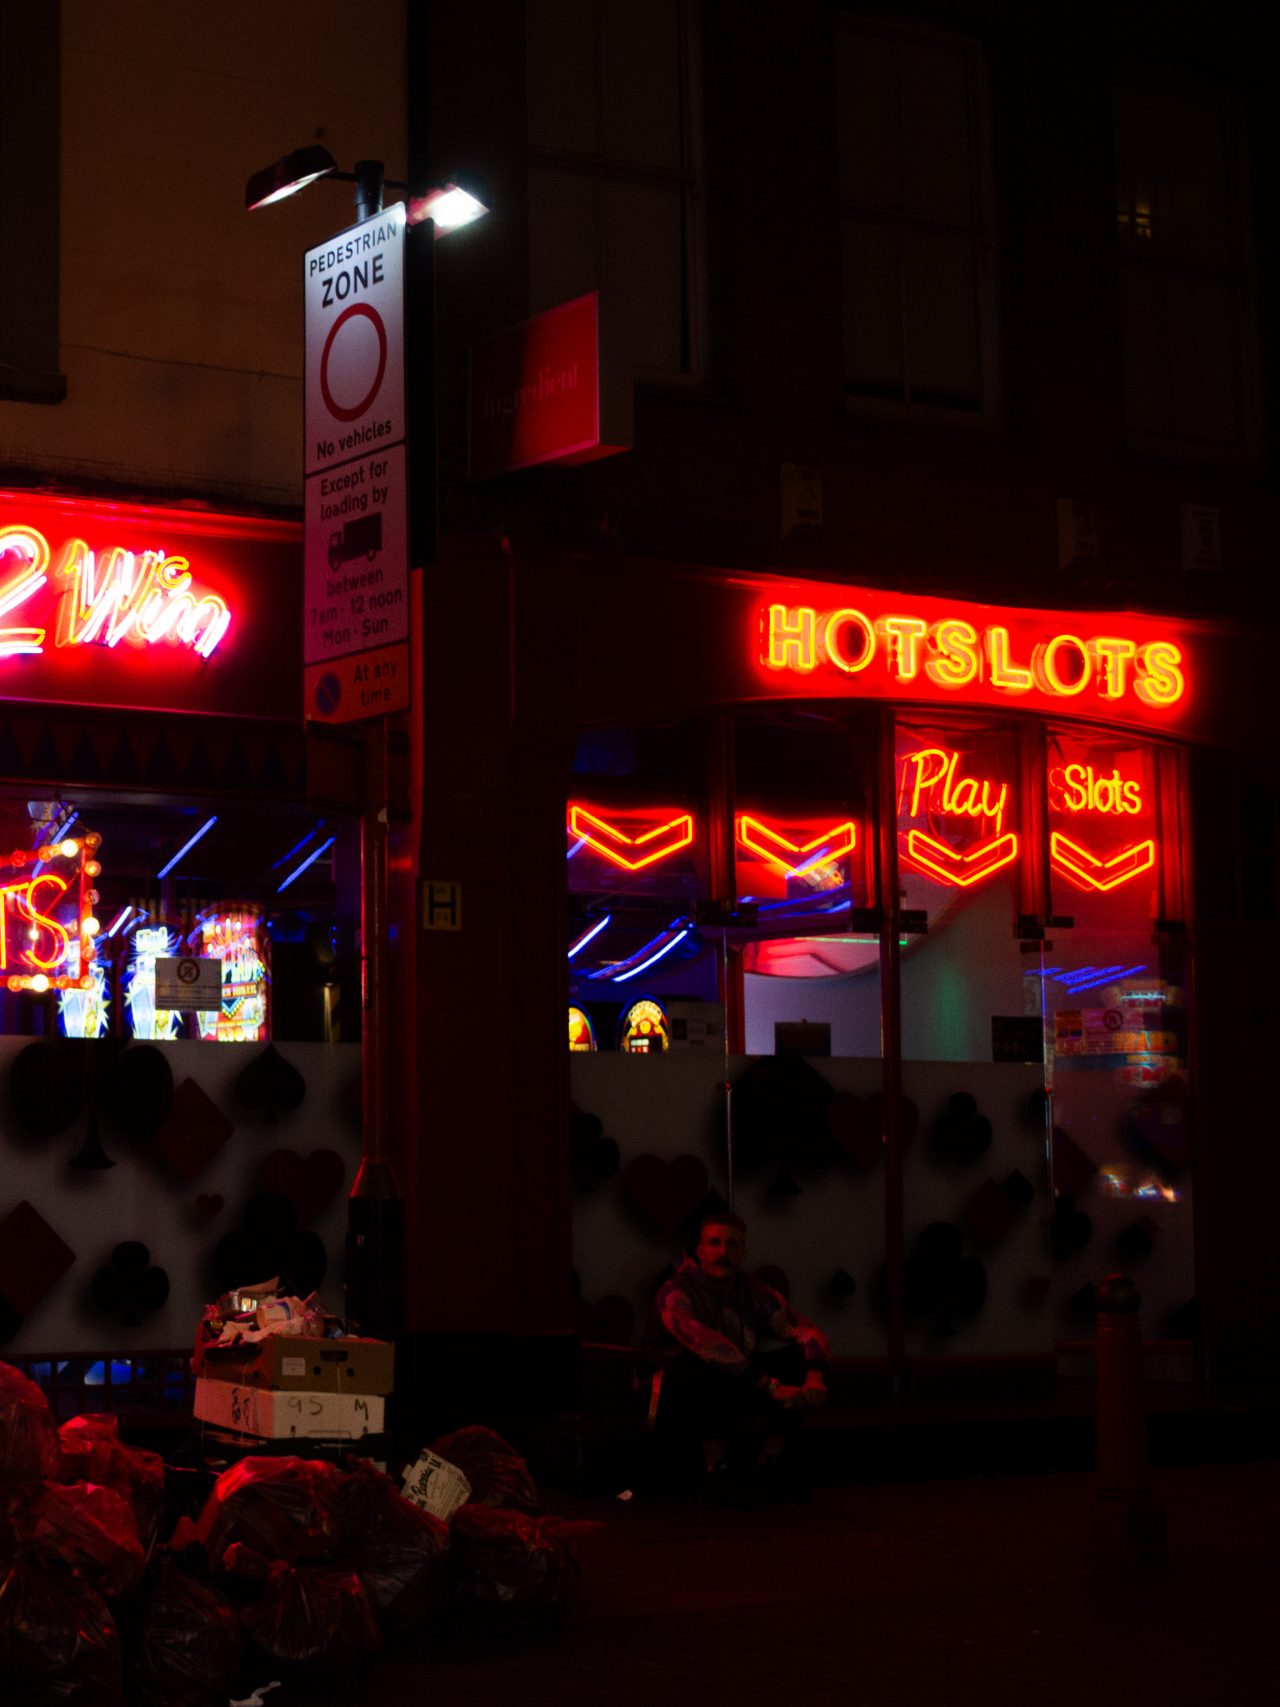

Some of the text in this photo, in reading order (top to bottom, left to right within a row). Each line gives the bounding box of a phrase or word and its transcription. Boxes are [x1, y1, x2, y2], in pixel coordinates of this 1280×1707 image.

[309, 221, 397, 278] PEDESTRIAN
[322, 254, 385, 309] ZONE
[316, 419, 392, 461] No vehicles
[321, 460, 389, 497] Except for
[320, 485, 389, 522] loading by
[58, 539, 232, 659] Win
[327, 567, 384, 598] between
[349, 595, 365, 616] 12
[370, 587, 403, 610] noon
[322, 625, 351, 649] Mon
[362, 617, 389, 638] Sun
[353, 658, 398, 683] At any
[359, 686, 391, 708] time
[908, 748, 1008, 838] Play
[1063, 763, 1142, 814] Slots
[428, 884, 456, 925] H
